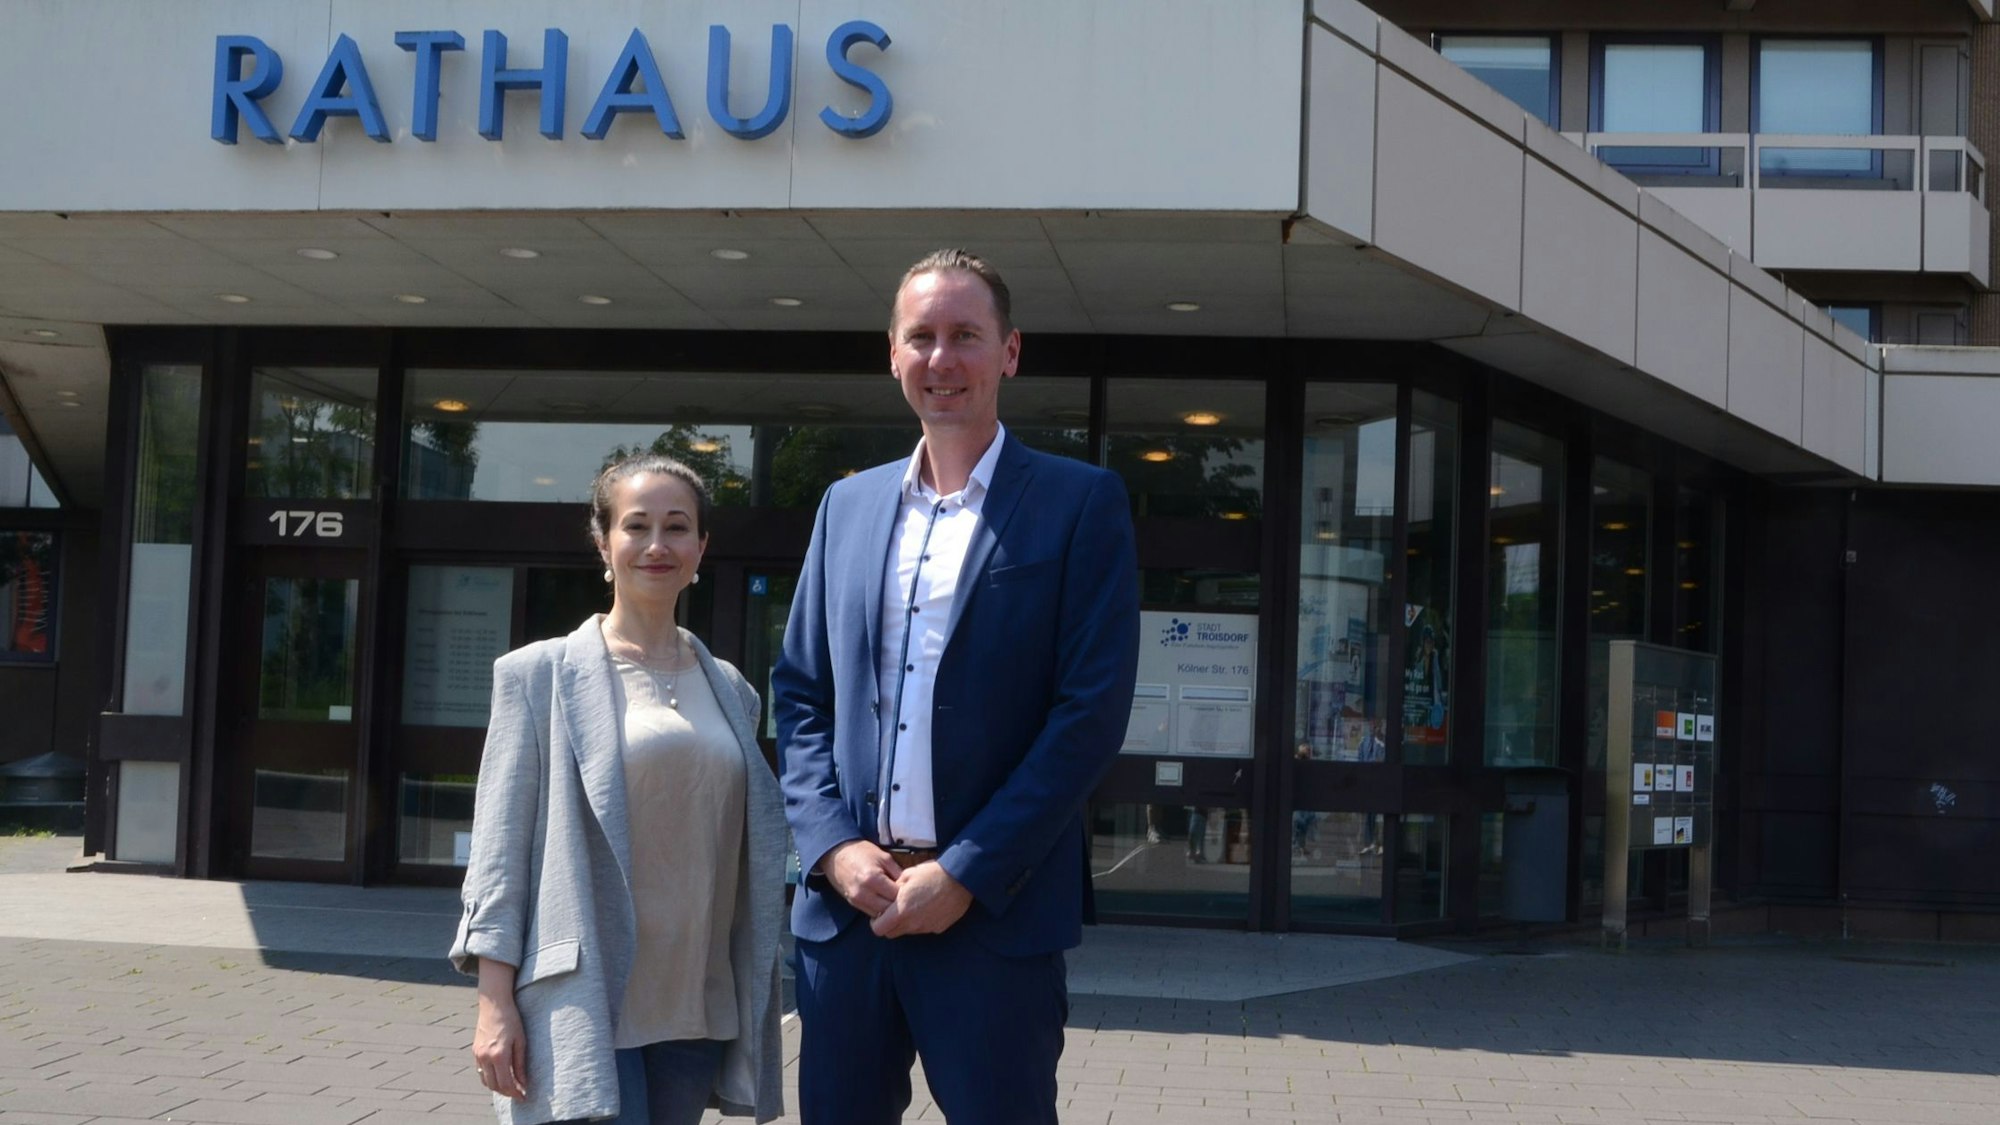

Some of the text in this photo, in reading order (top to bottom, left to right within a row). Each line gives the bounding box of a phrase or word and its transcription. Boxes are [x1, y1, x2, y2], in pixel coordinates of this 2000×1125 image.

[210, 20, 894, 145] RATHAUS
[268, 510, 344, 538] 176
[1197, 623, 1221, 632] STADT
[1197, 632, 1249, 642] TROISDORF
[1177, 663, 1249, 675] Kölner Str. 176
